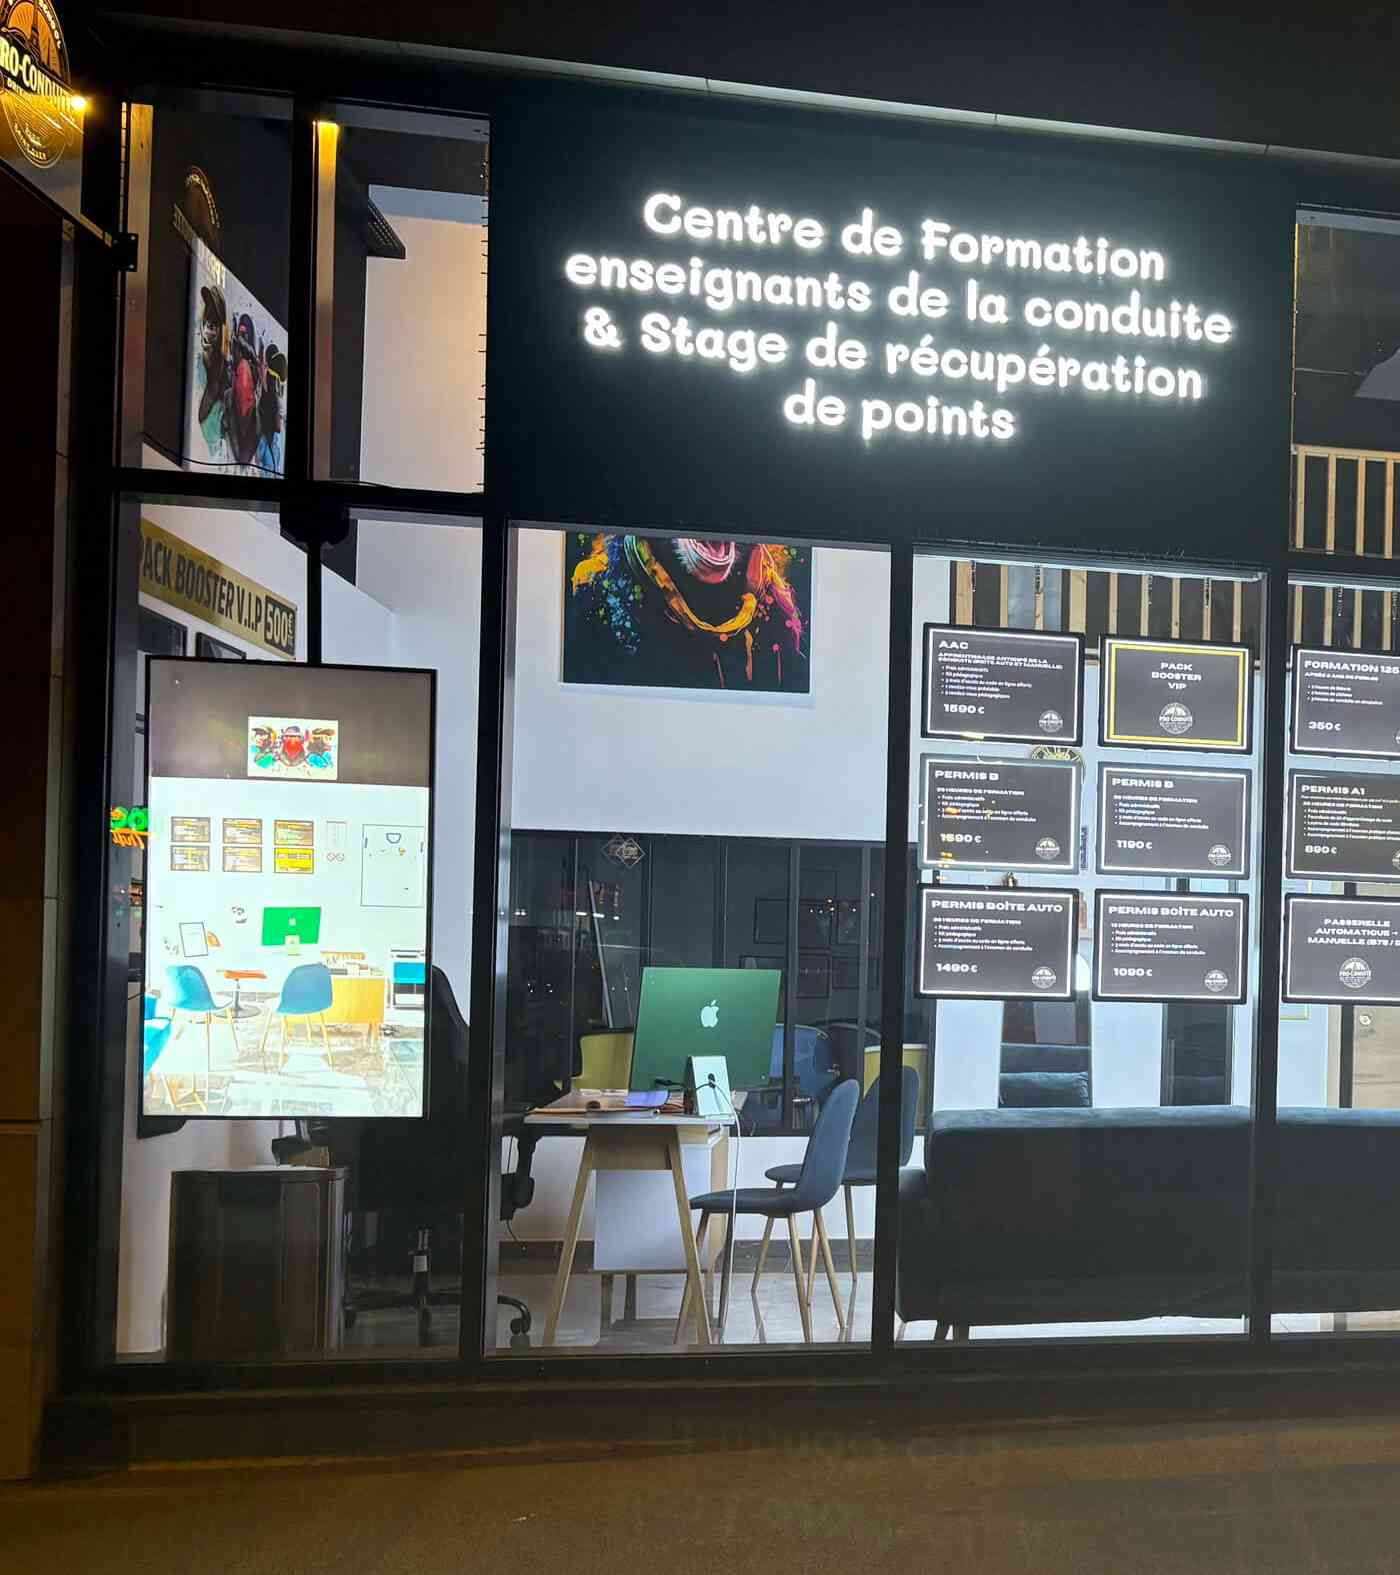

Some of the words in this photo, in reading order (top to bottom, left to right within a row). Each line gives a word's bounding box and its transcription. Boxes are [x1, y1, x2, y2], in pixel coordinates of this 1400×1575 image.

[644, 193, 824, 250] Centre
[841, 208, 902, 257] de
[921, 218, 1166, 281] Formation
[565, 253, 872, 312] enseignants
[888, 270, 949, 319] de
[966, 279, 1009, 325] la
[1024, 290, 1232, 344] conduite
[584, 306, 623, 349] &
[641, 312, 787, 373] Stage
[805, 322, 867, 370] de
[885, 334, 1205, 400] récupération
[783, 378, 846, 426] de
[861, 395, 1017, 440] points
[143, 537, 173, 592] ACK
[176, 553, 235, 620] BOOSTER
[266, 604, 288, 648] 500
[938, 640, 969, 650] AAC
[1160, 662, 1193, 671] PACK
[1304, 660, 1379, 673] FORMATION
[1380, 665, 1400, 674] 125
[1151, 671, 1202, 681] BOOSTER
[1167, 682, 1187, 690] VIP
[935, 770, 986, 780] PERMIS
[989, 773, 999, 781] B
[1112, 778, 1162, 788] PERMIS
[1301, 785, 1349, 794] PERMIS
[931, 900, 985, 910] PERMIS
[986, 901, 1025, 911] BOÎTE
[1027, 903, 1063, 912] AUTO
[1108, 906, 1159, 915] PERMIS
[1160, 906, 1198, 917] BOÎTE
[1199, 908, 1234, 918] AUTO
[1324, 918, 1390, 927] PASSERELLE
[1315, 928, 1390, 937] AUTOMATIQUE
[1307, 937, 1366, 945] MANUELLE
